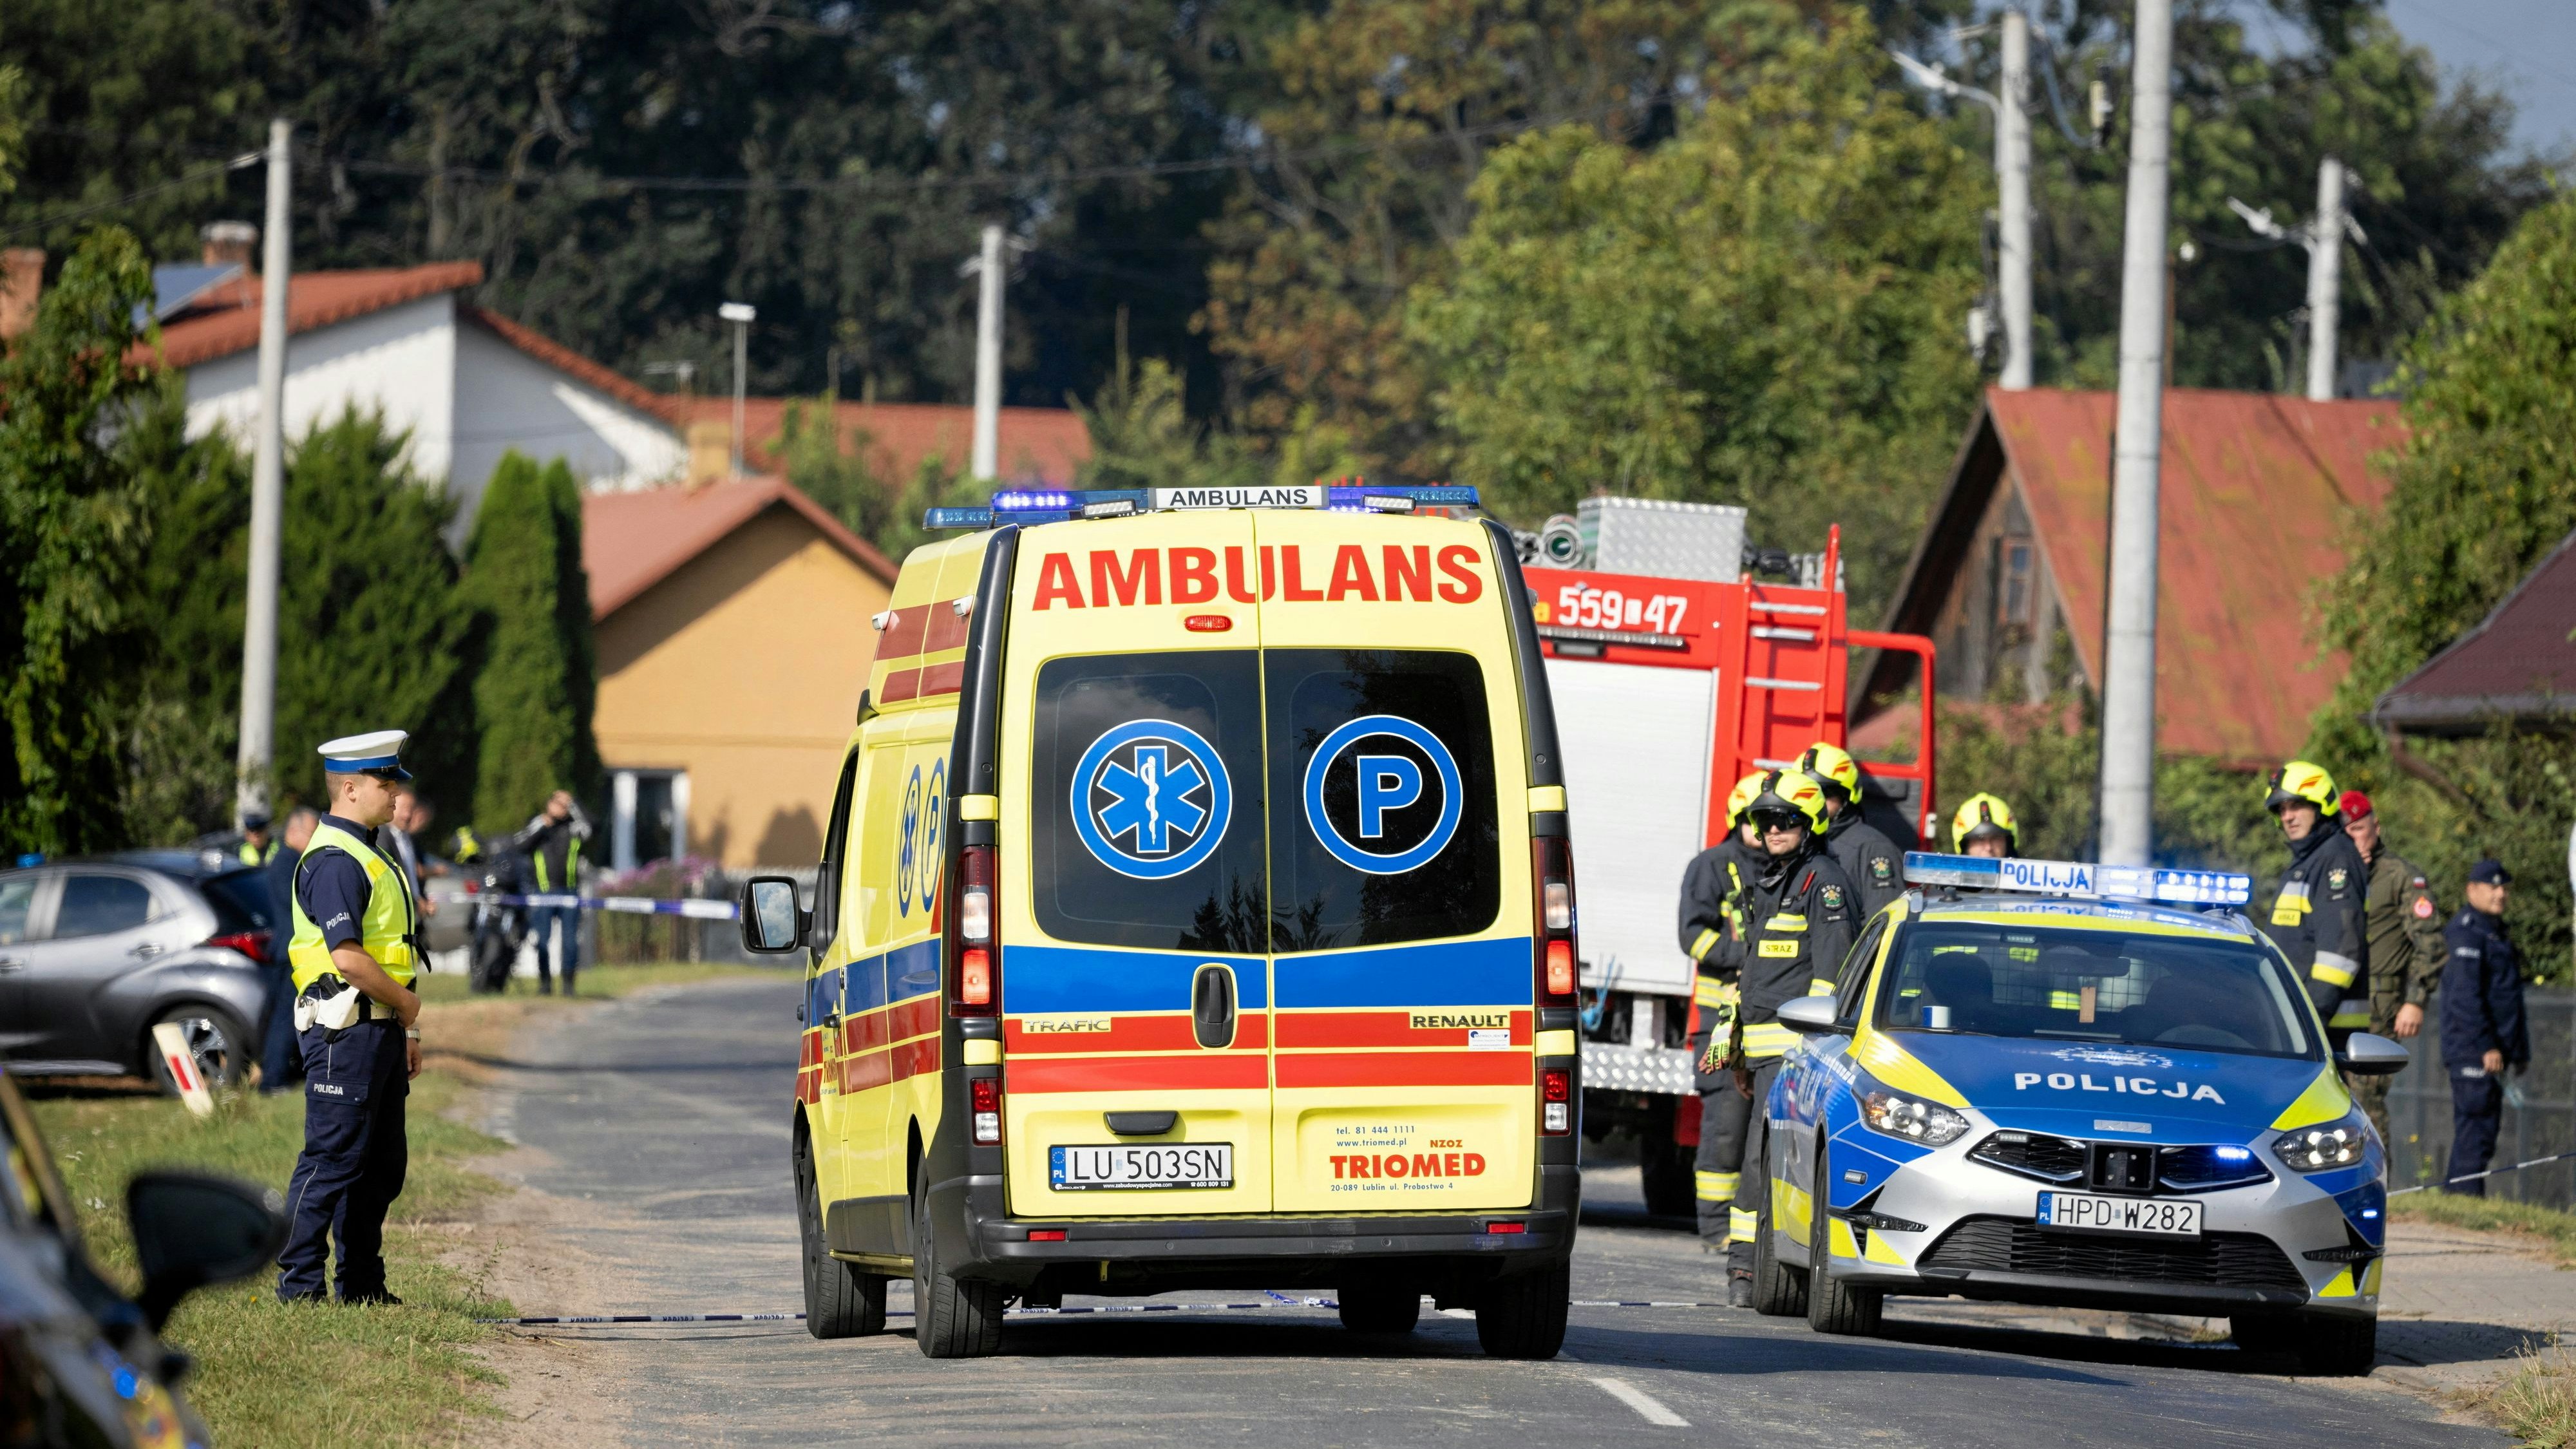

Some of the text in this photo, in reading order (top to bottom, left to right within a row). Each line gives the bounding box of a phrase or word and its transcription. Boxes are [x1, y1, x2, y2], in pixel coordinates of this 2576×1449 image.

[1169, 488, 1309, 506] AMBULANS
[1032, 544, 1483, 611] AMBULANS
[1558, 585, 1624, 630] 559
[1643, 594, 1688, 634] 47
[1357, 755, 1423, 838] P
[326, 912, 351, 930] POLICJA
[1025, 1019, 1110, 1032] TRAFIC
[1412, 1015, 1508, 1028] RENAULT
[314, 1083, 343, 1095] POLICJA
[2014, 1073, 2226, 1105] POLICJA
[1337, 1138, 1407, 1148] www.triomed.pl
[1053, 1150, 1222, 1180] PL LU 503SN
[1329, 1153, 1486, 1179] TRIOMED
[2039, 1197, 2193, 1232] PL HPD W282
